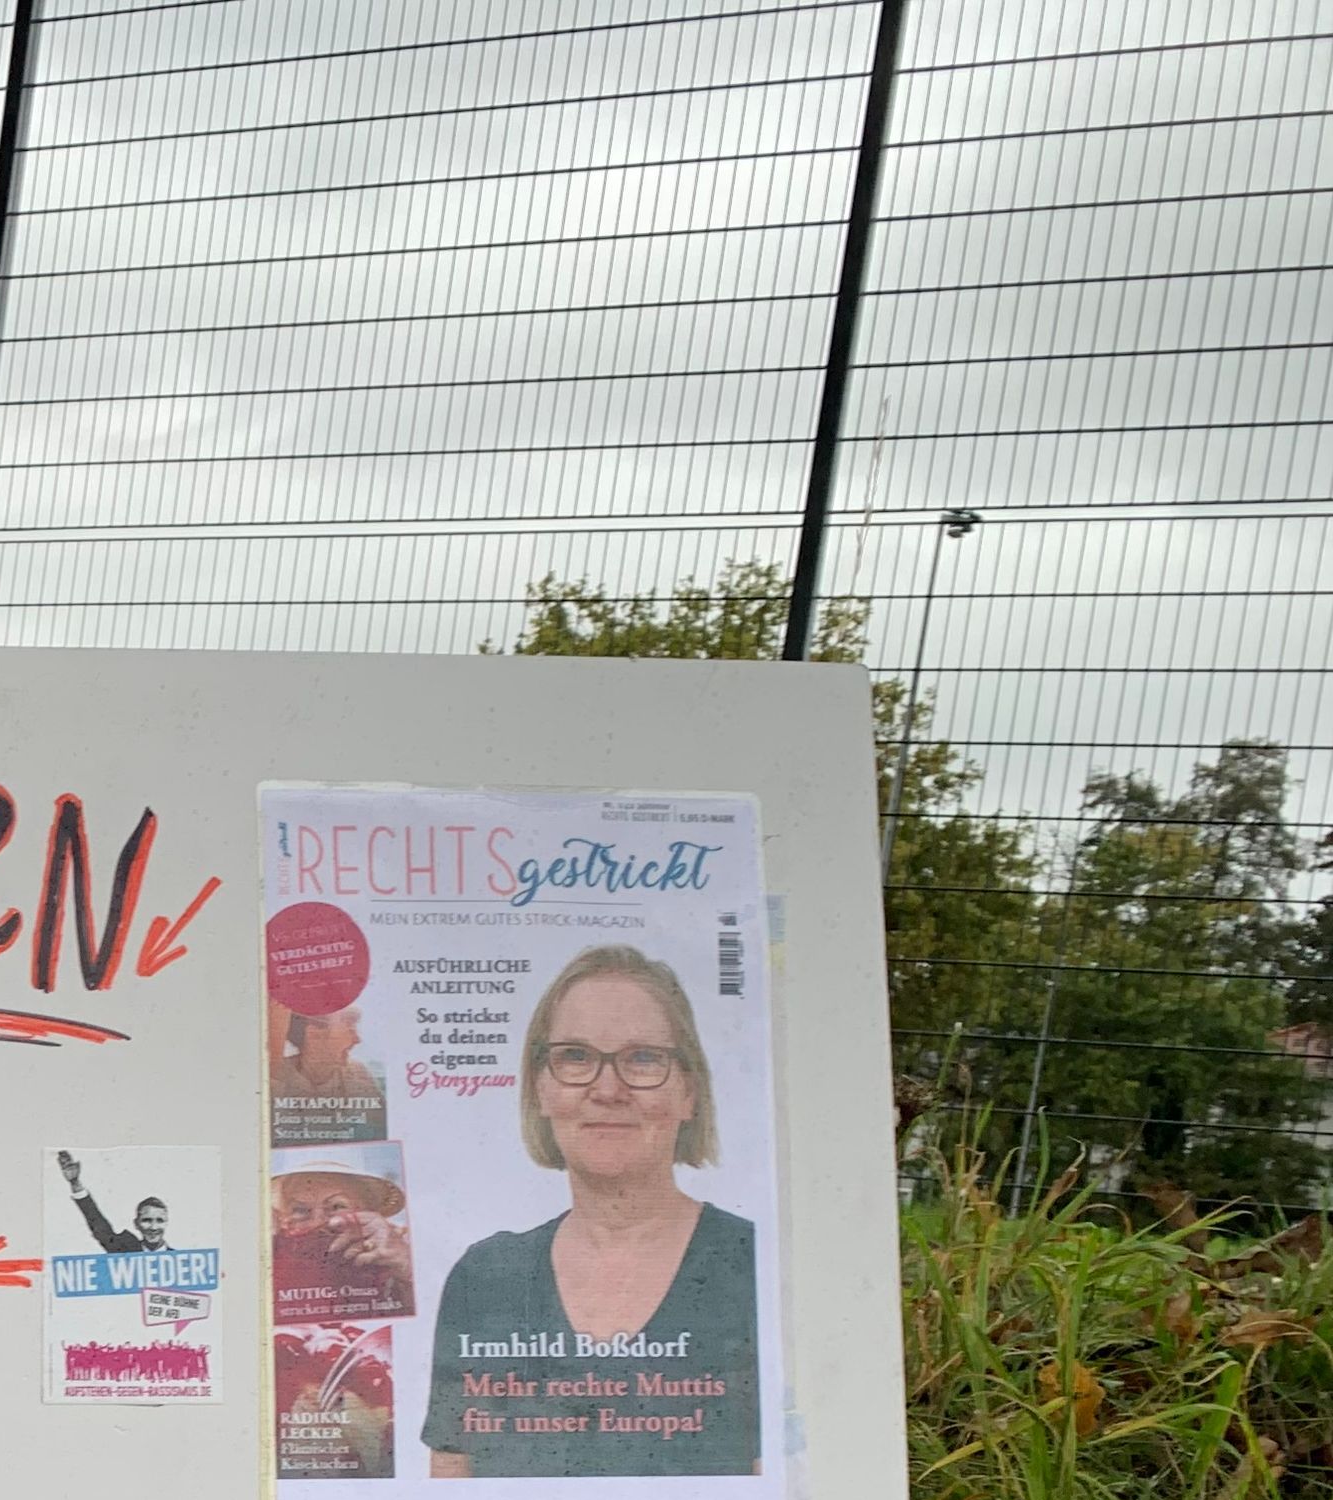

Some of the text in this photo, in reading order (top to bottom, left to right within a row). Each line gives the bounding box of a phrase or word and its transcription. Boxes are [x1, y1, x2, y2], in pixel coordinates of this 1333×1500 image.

[370, 912, 408, 925] MEIN
[413, 912, 471, 926] EXTREM
[475, 913, 522, 926] GUTES
[393, 957, 531, 973] AUSFÜHRLICHE
[410, 980, 516, 994] ANLEITUNG
[416, 1008, 510, 1024] So strickst
[420, 1028, 507, 1044] du deinen
[430, 1051, 498, 1069] eigenen
[406, 1062, 516, 1098] Grenzzaun
[274, 1096, 382, 1109] METAPOLITIK
[55, 1251, 216, 1292] NIE WIEDER!
[278, 1285, 379, 1301] MUTIG: Omas
[458, 1332, 691, 1358] Irmhild Boßdorf
[462, 1371, 727, 1397] Mehr rechte Muttis
[280, 1411, 352, 1424] RADIKAL
[463, 1408, 704, 1440] für unser Europa!
[280, 1427, 342, 1439] LECKER
